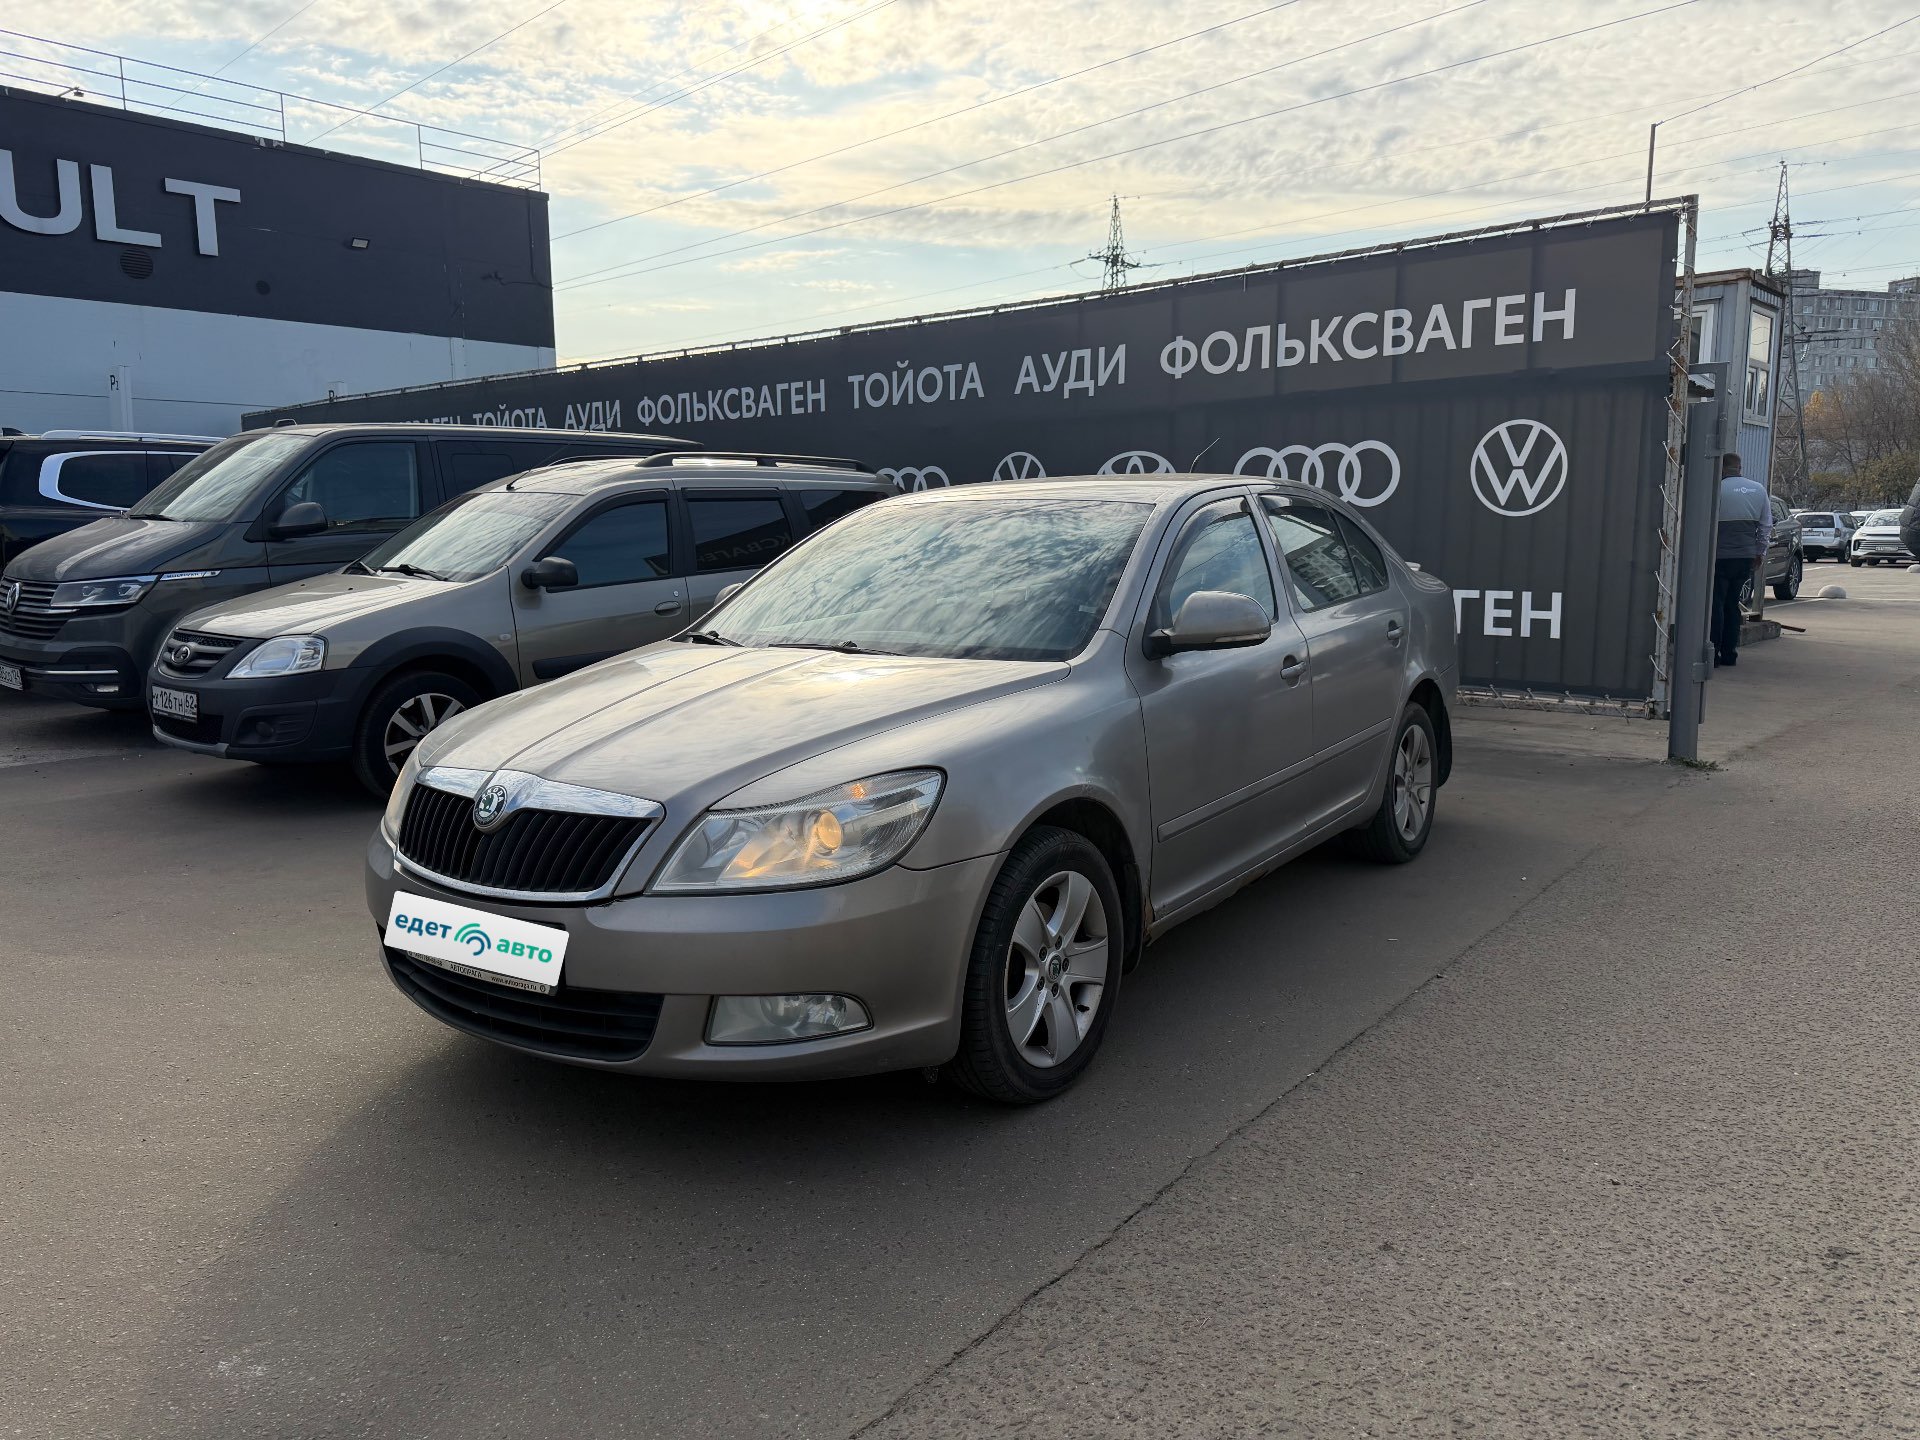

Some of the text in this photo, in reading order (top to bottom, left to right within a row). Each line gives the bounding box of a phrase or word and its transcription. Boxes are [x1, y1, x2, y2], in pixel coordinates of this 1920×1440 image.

[0, 149, 241, 257] ULT
[564, 400, 621, 432] АУДИ
[637, 379, 826, 427] ФОЛЬКСВАГЕН
[848, 361, 985, 409] ТОЙОТА
[1013, 344, 1126, 399] АУДИ
[1159, 288, 1577, 379] ФОЛЬКСВАГЕН
